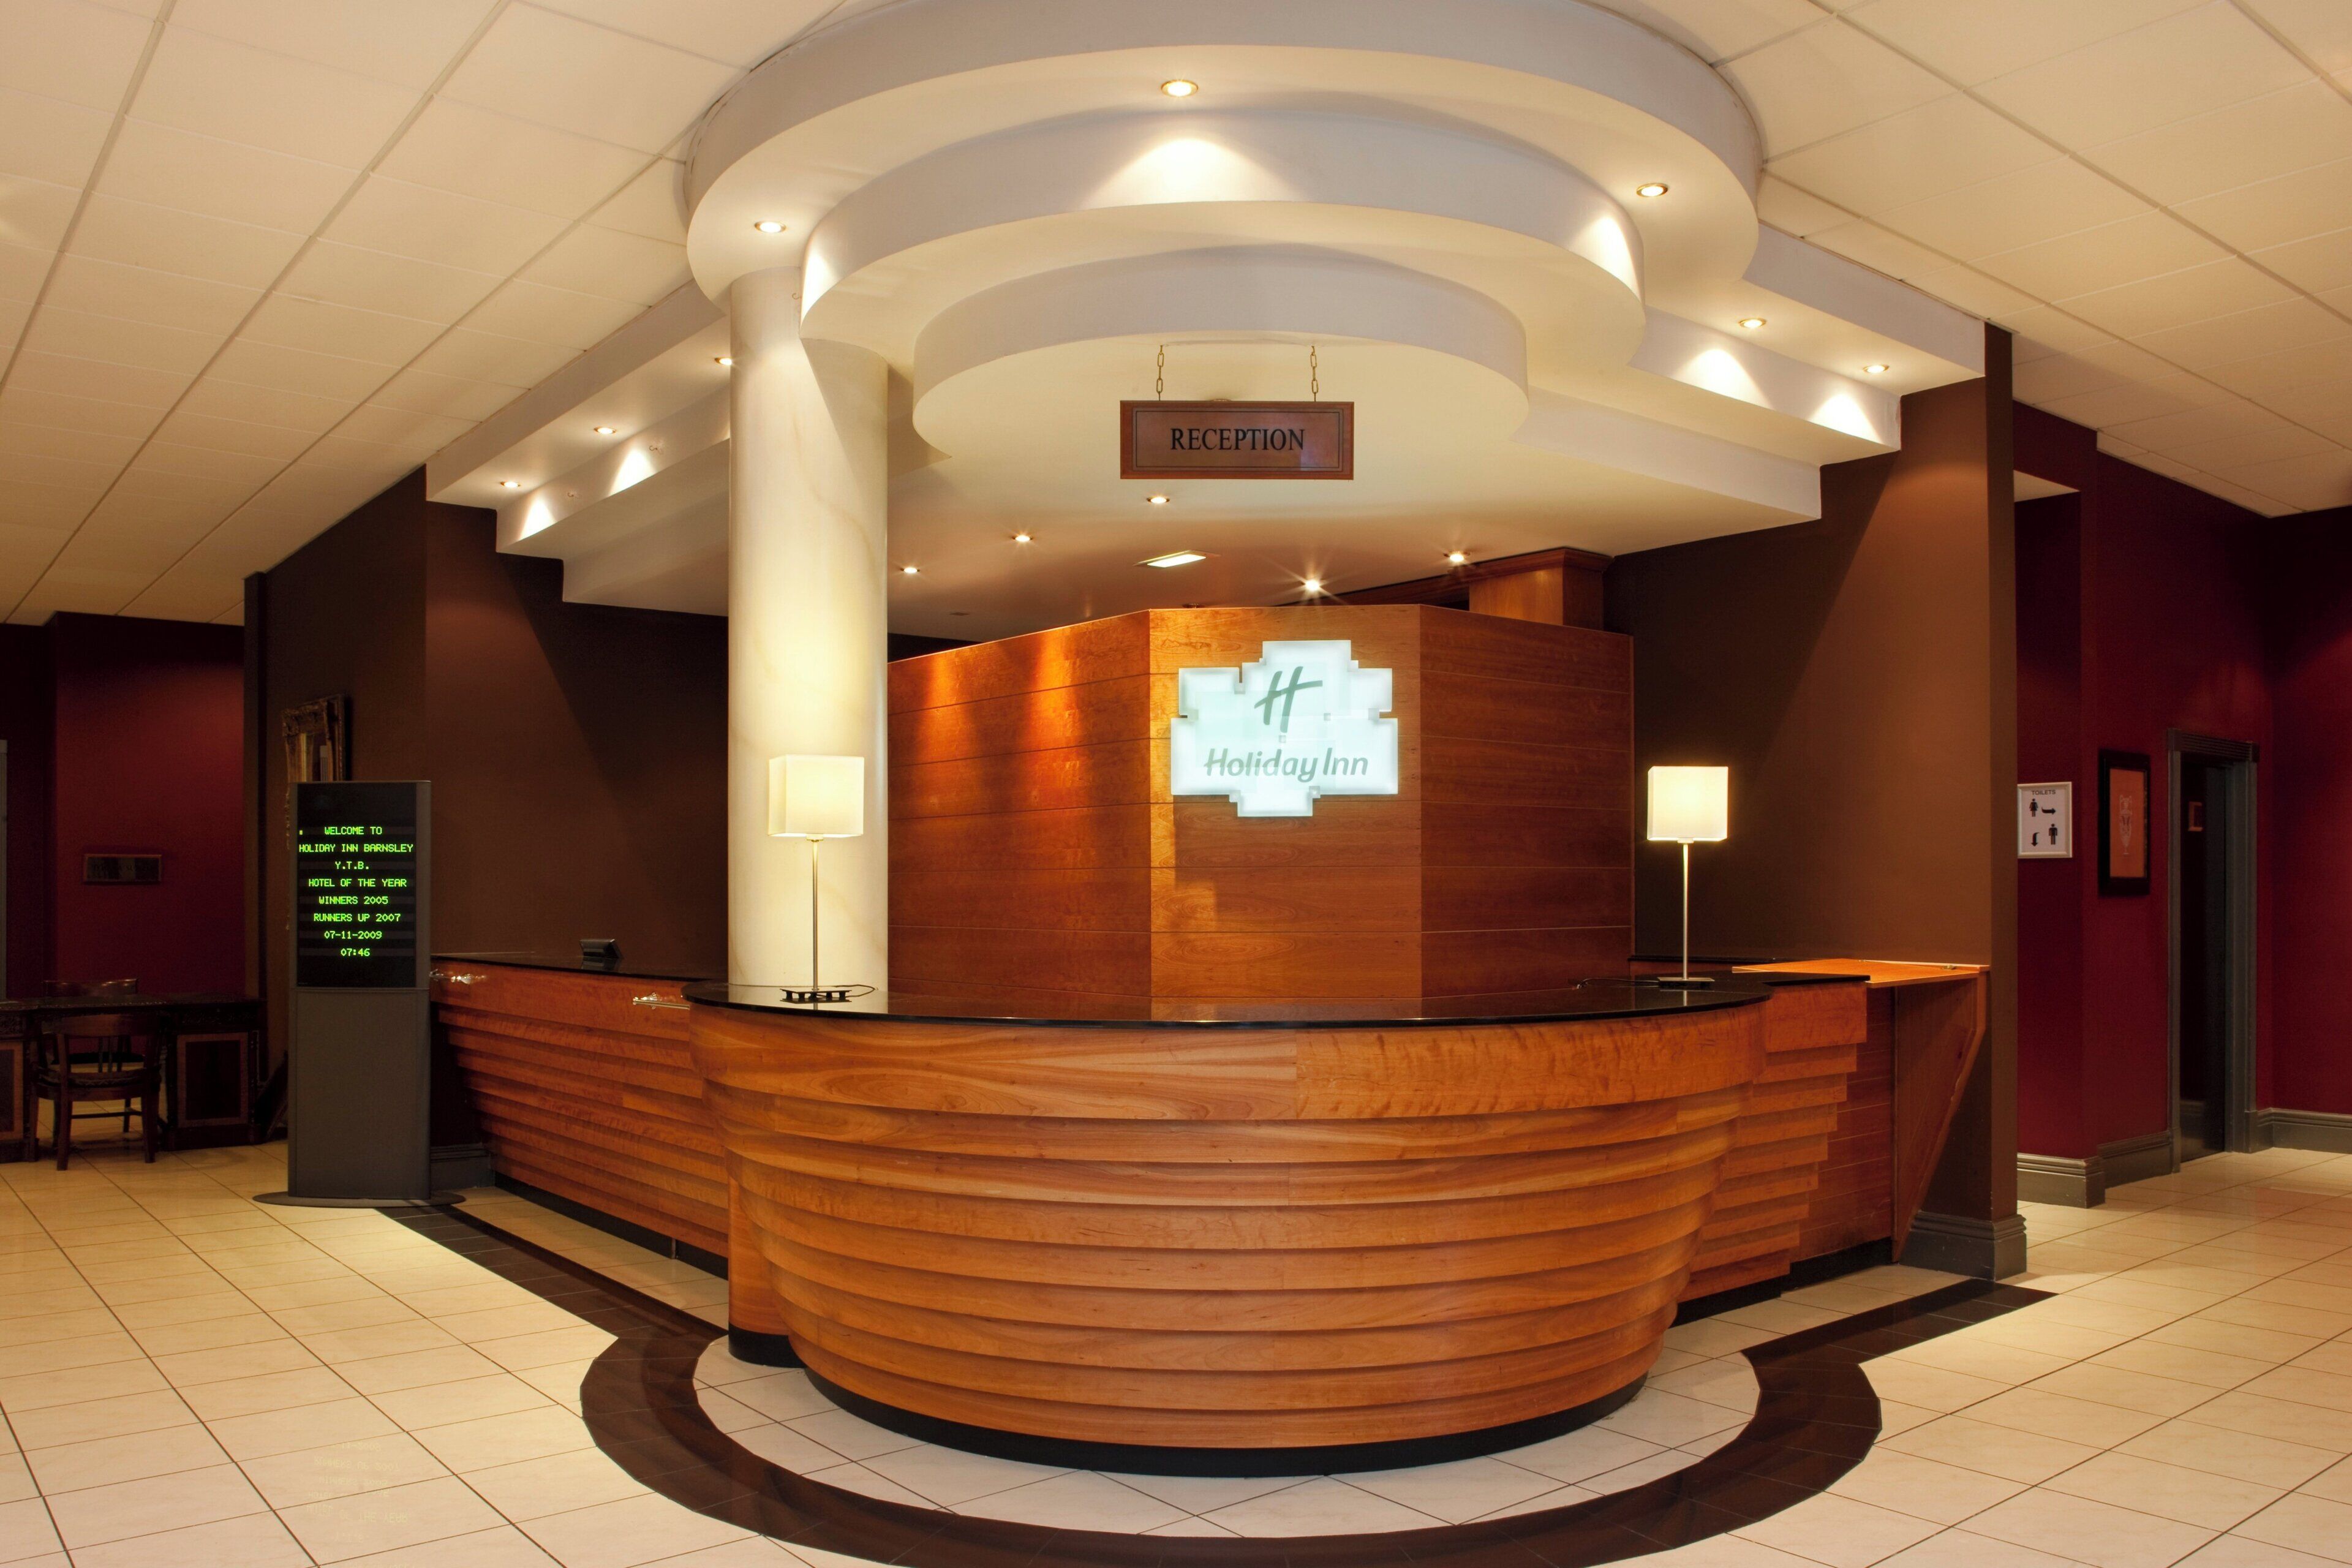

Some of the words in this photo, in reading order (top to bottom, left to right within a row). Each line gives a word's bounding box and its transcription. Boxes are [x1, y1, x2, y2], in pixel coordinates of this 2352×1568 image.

[1170, 428, 1305, 450] RECEPTION
[1254, 666, 1323, 733] H
[1204, 748, 1318, 783] Holiday
[1322, 747, 1368, 775] Inn
[324, 826, 364, 835] WELCOME
[369, 826, 383, 835] TO
[298, 843, 336, 853] HOLIDAY
[341, 843, 359, 853] INN
[363, 843, 413, 853] BARNSLEY
[334, 861, 369, 870] Y.T.B.
[308, 878, 336, 888] HOTEL
[340, 878, 352, 888] OF
[357, 878, 376, 888] THE
[382, 878, 407, 888] YEAR
[318, 895, 358, 905] WINNERS
[363, 895, 389, 905] 2005
[313, 913, 353, 922] RUNNERS
[357, 913, 371, 922] UP
[375, 913, 401, 922] 2007
[323, 930, 383, 940] 07-11-2009
[340, 948, 371, 957] 07:46
